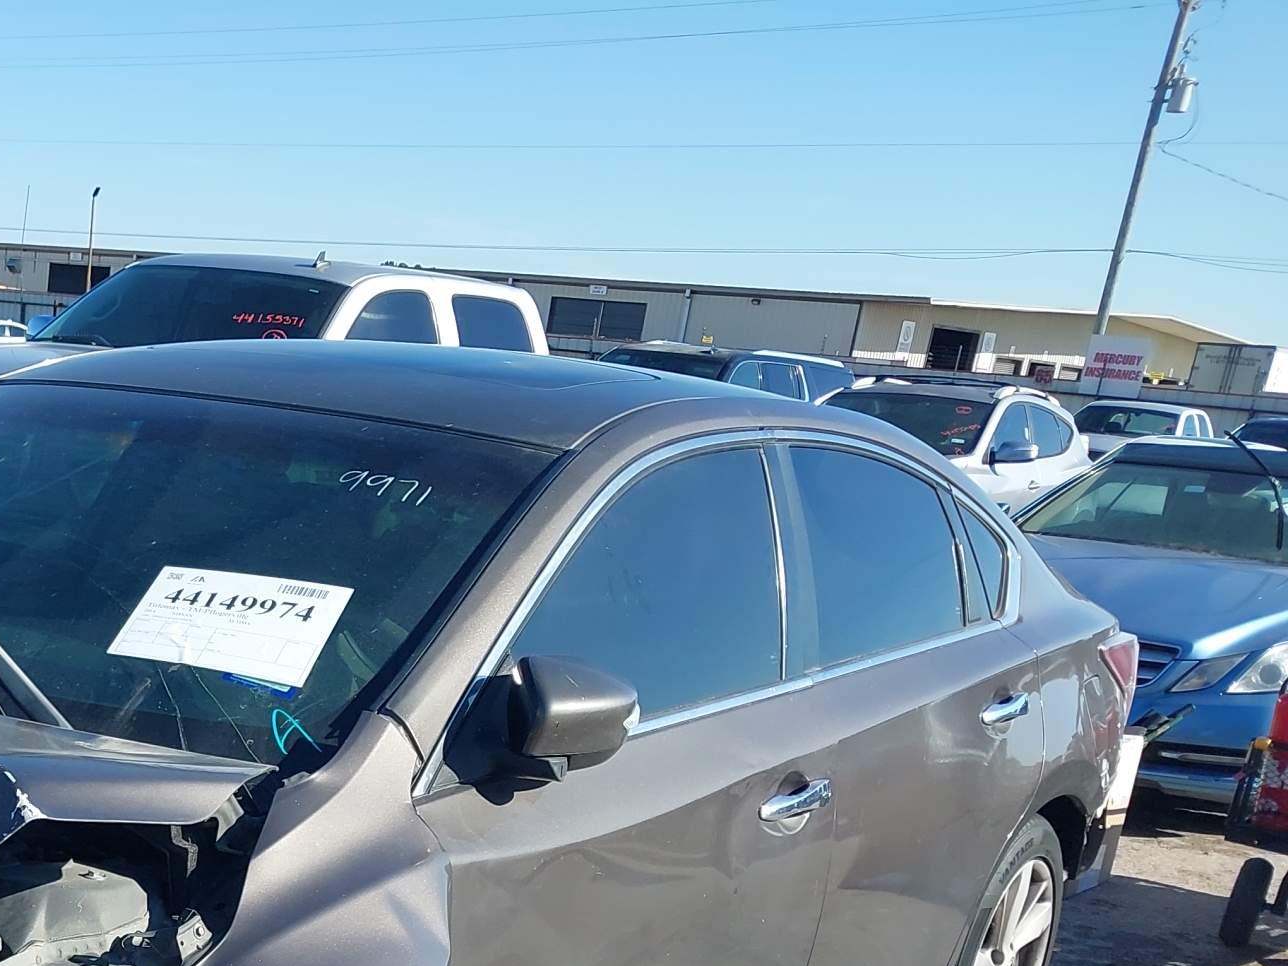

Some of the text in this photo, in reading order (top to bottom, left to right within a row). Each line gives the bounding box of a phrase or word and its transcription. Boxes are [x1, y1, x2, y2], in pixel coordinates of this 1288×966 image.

[1093, 352, 1144, 366] MERCURY
[1084, 366, 1143, 382] INSURANCE
[339, 470, 433, 506] 9971
[163, 588, 316, 622] 44149974
